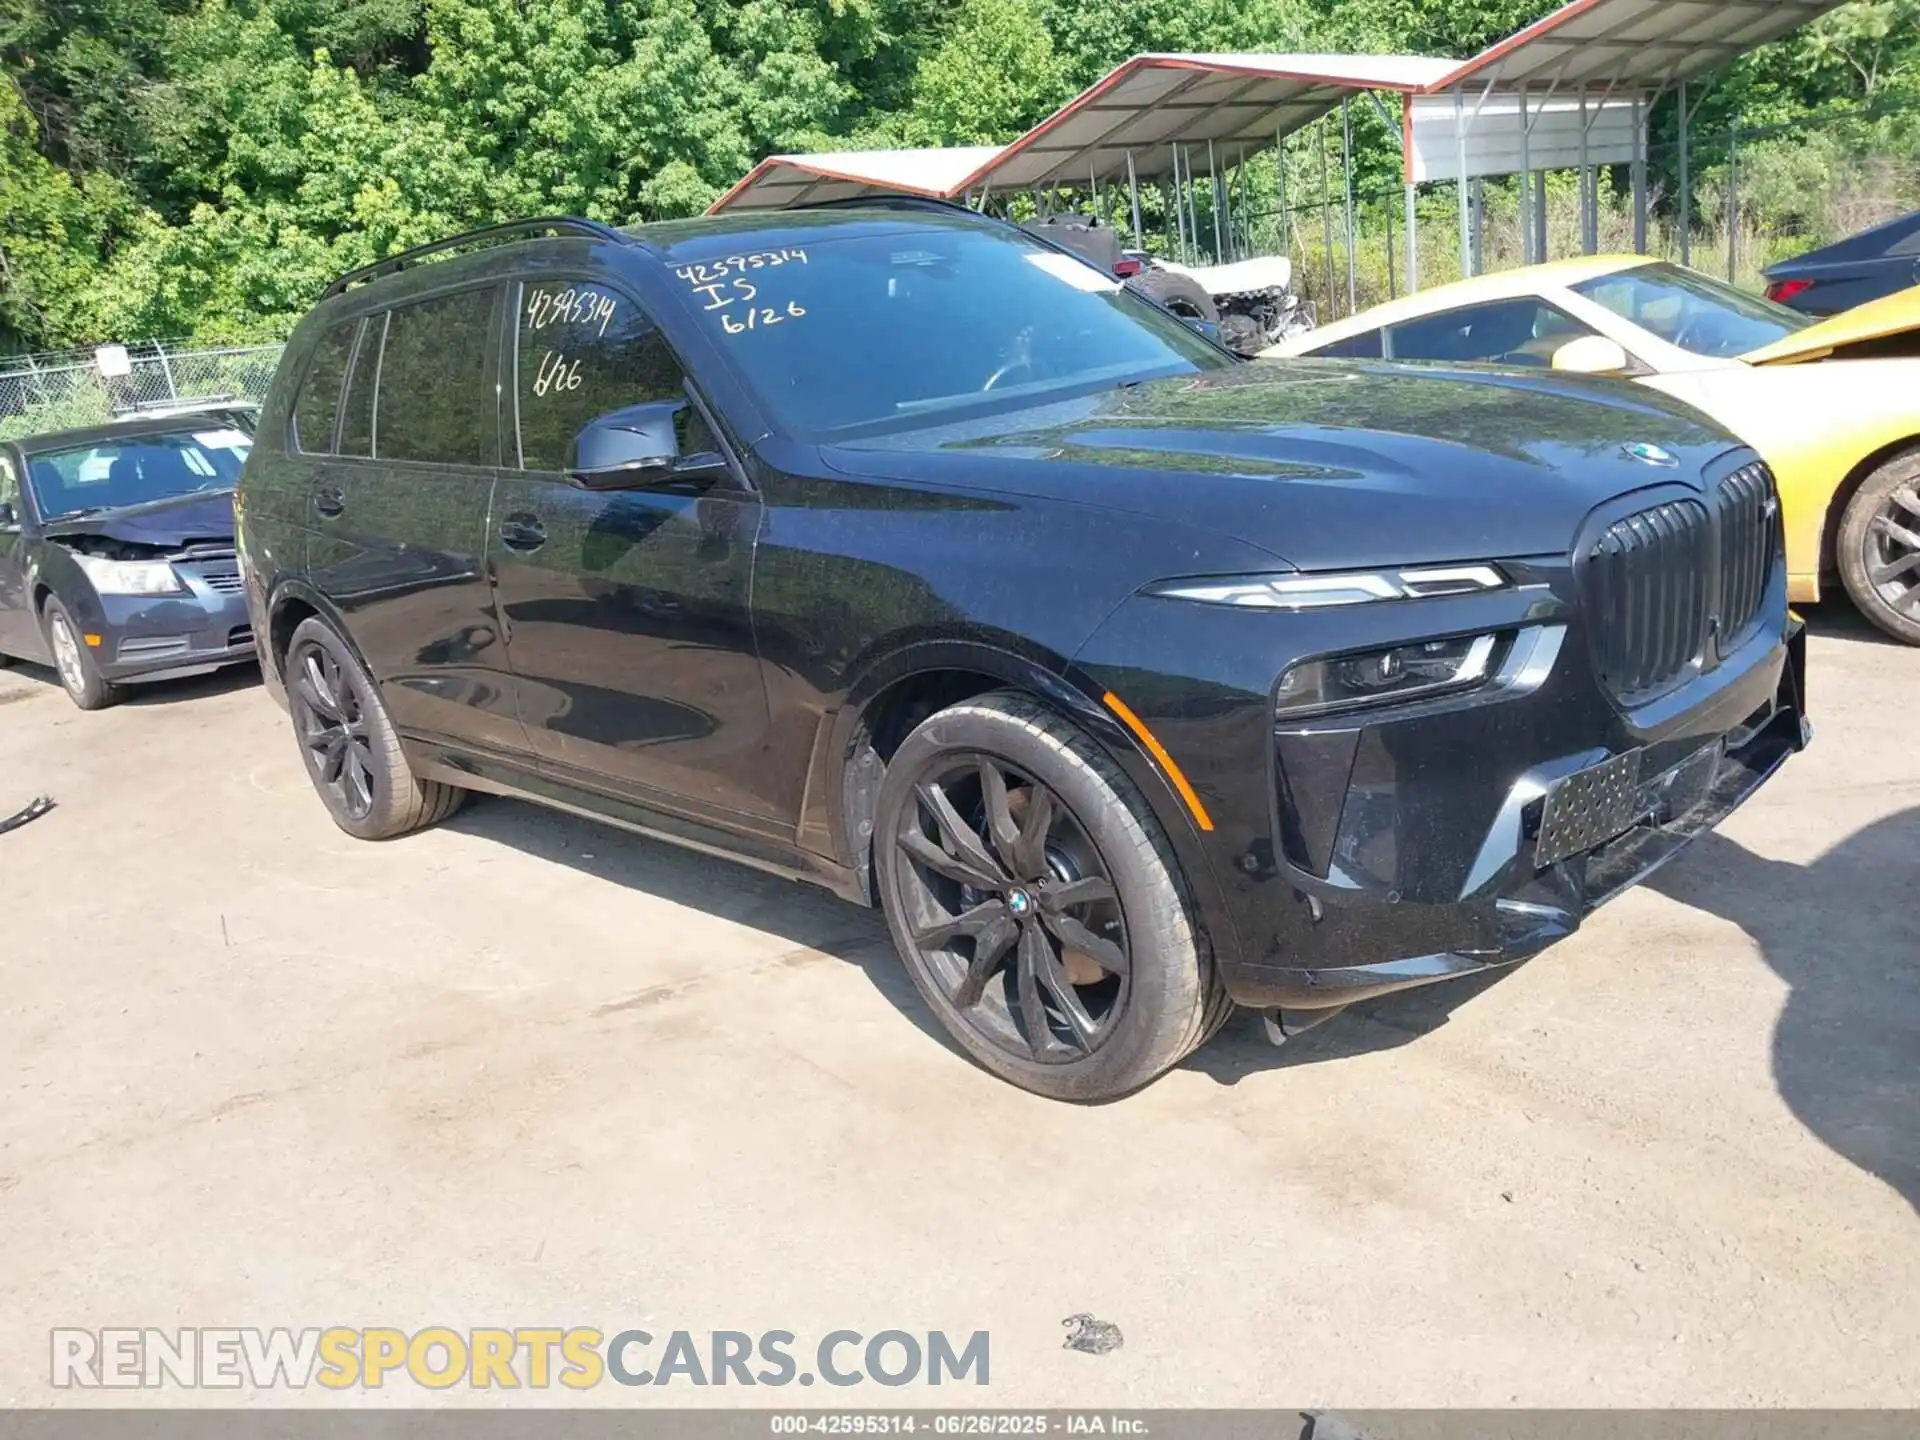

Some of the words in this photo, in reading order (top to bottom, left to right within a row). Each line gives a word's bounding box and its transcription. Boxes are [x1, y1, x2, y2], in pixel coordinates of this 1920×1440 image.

[676, 249, 808, 285] 42595314
[527, 288, 617, 337] 42595314
[721, 300, 807, 334] 6/26
[533, 350, 582, 397] 6/26
